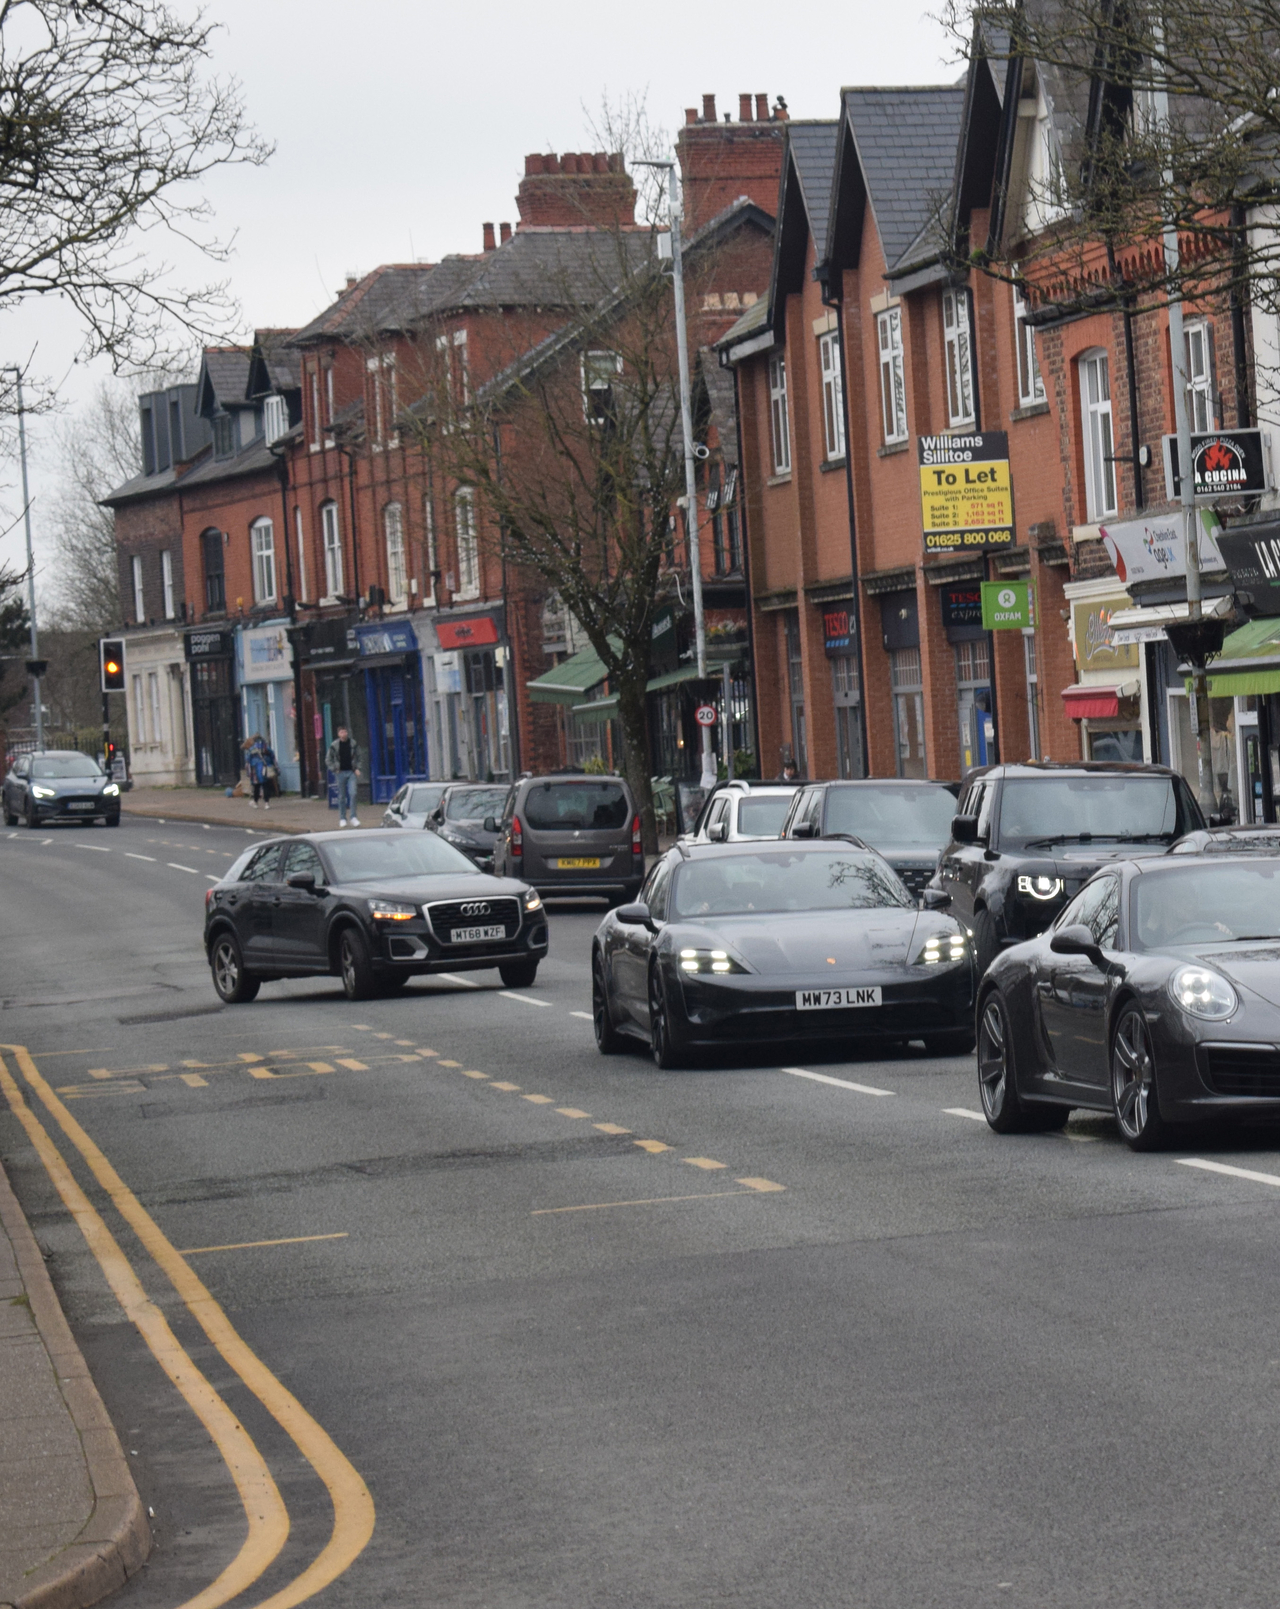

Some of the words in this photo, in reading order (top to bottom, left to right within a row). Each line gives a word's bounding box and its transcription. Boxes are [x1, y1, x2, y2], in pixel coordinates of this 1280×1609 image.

[921, 435, 983, 450] Williams
[1202, 437, 1218, 447] FIRED
[1219, 437, 1235, 447] PIZZA
[1234, 444, 1246, 459] OVEN
[923, 449, 972, 464] Sillitoe
[933, 470, 957, 486] To
[964, 467, 998, 485] Let
[1195, 471, 1202, 484] A
[1205, 468, 1247, 483] CUCINA
[923, 489, 961, 497] Prestigious
[961, 493, 988, 501] Parking
[927, 534, 962, 547] 01625
[964, 532, 986, 544] 800
[988, 531, 1011, 543] 066
[1255, 541, 1277, 578] LA
[949, 592, 982, 603] TESC
[824, 611, 848, 637] TESCO
[994, 611, 1022, 622] OXFAM
[698, 710, 713, 720] 20
[456, 929, 481, 940] MT68
[484, 927, 501, 937] WZF
[803, 991, 841, 1006] MW73
[846, 989, 875, 1004] LNK
[56, 1054, 423, 1099] STOP
